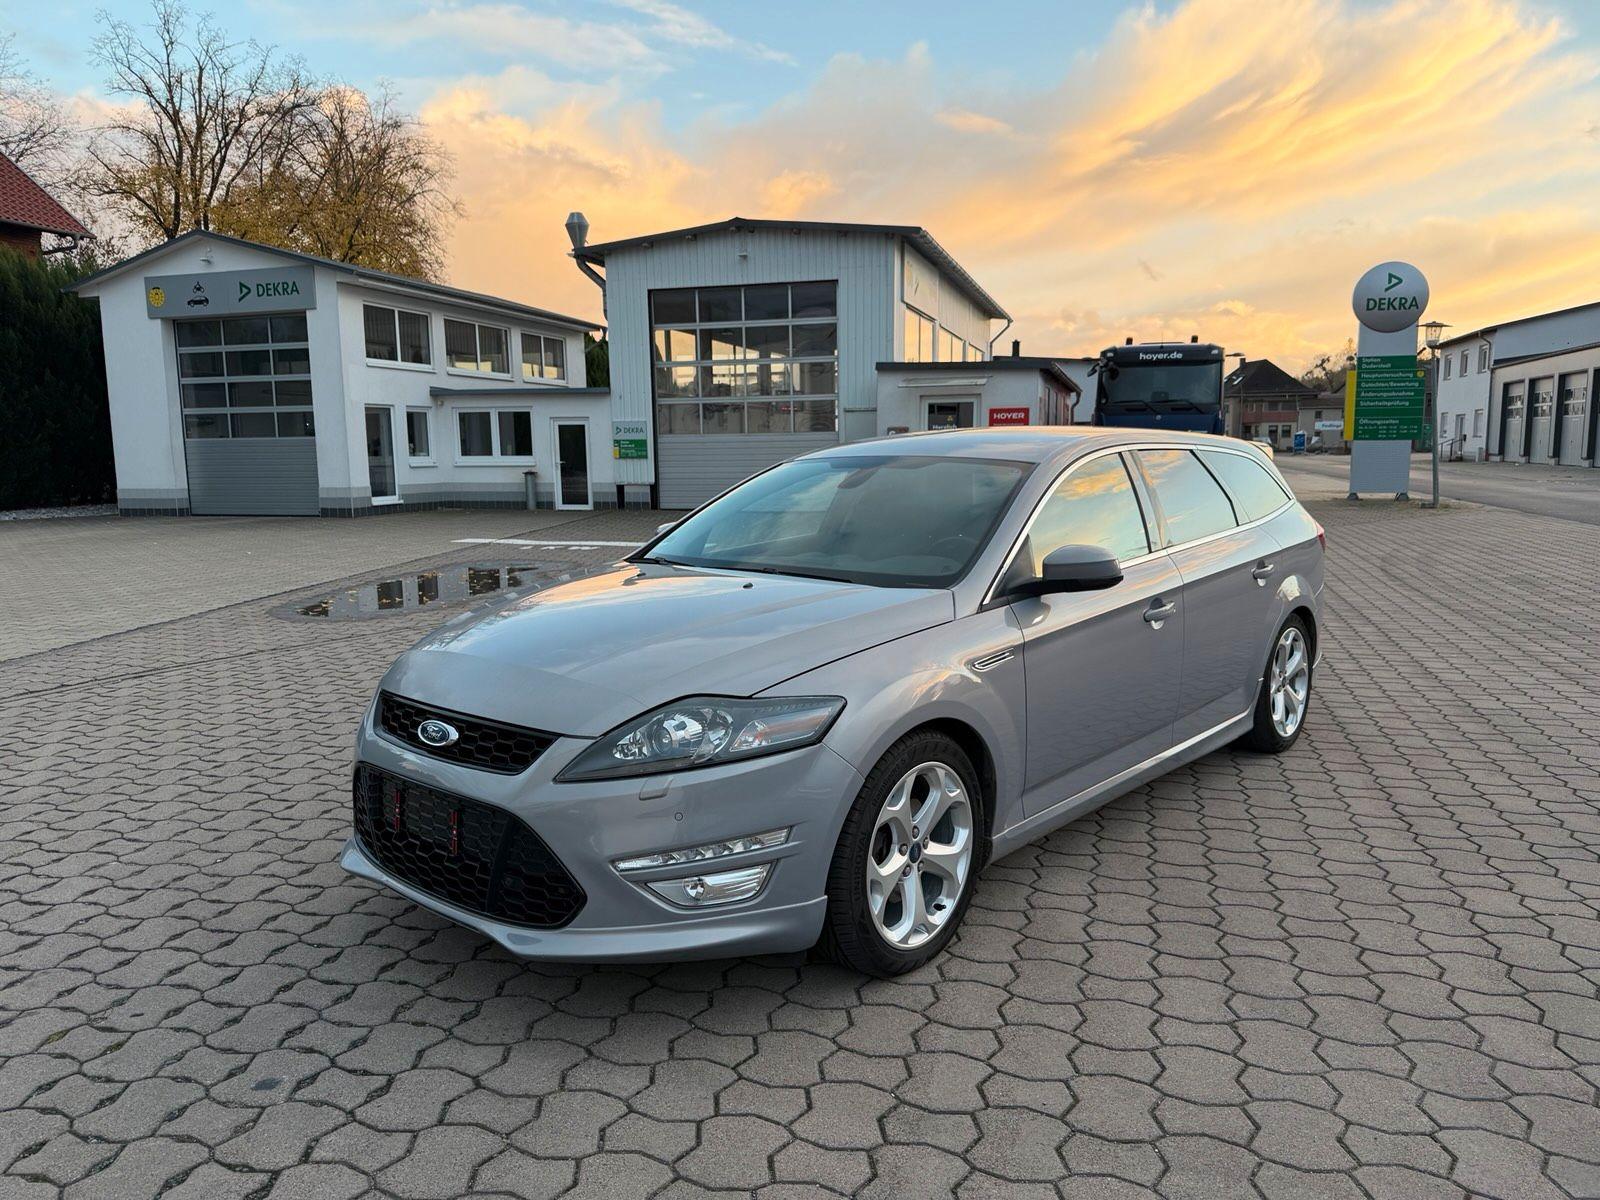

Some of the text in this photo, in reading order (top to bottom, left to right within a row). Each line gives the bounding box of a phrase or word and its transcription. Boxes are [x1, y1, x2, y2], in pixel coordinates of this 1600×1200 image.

[256, 281, 300, 297] DEKRA
[1366, 296, 1419, 311] DEKRA
[1139, 351, 1183, 361] hoyer.de
[993, 412, 1025, 420] HOYER
